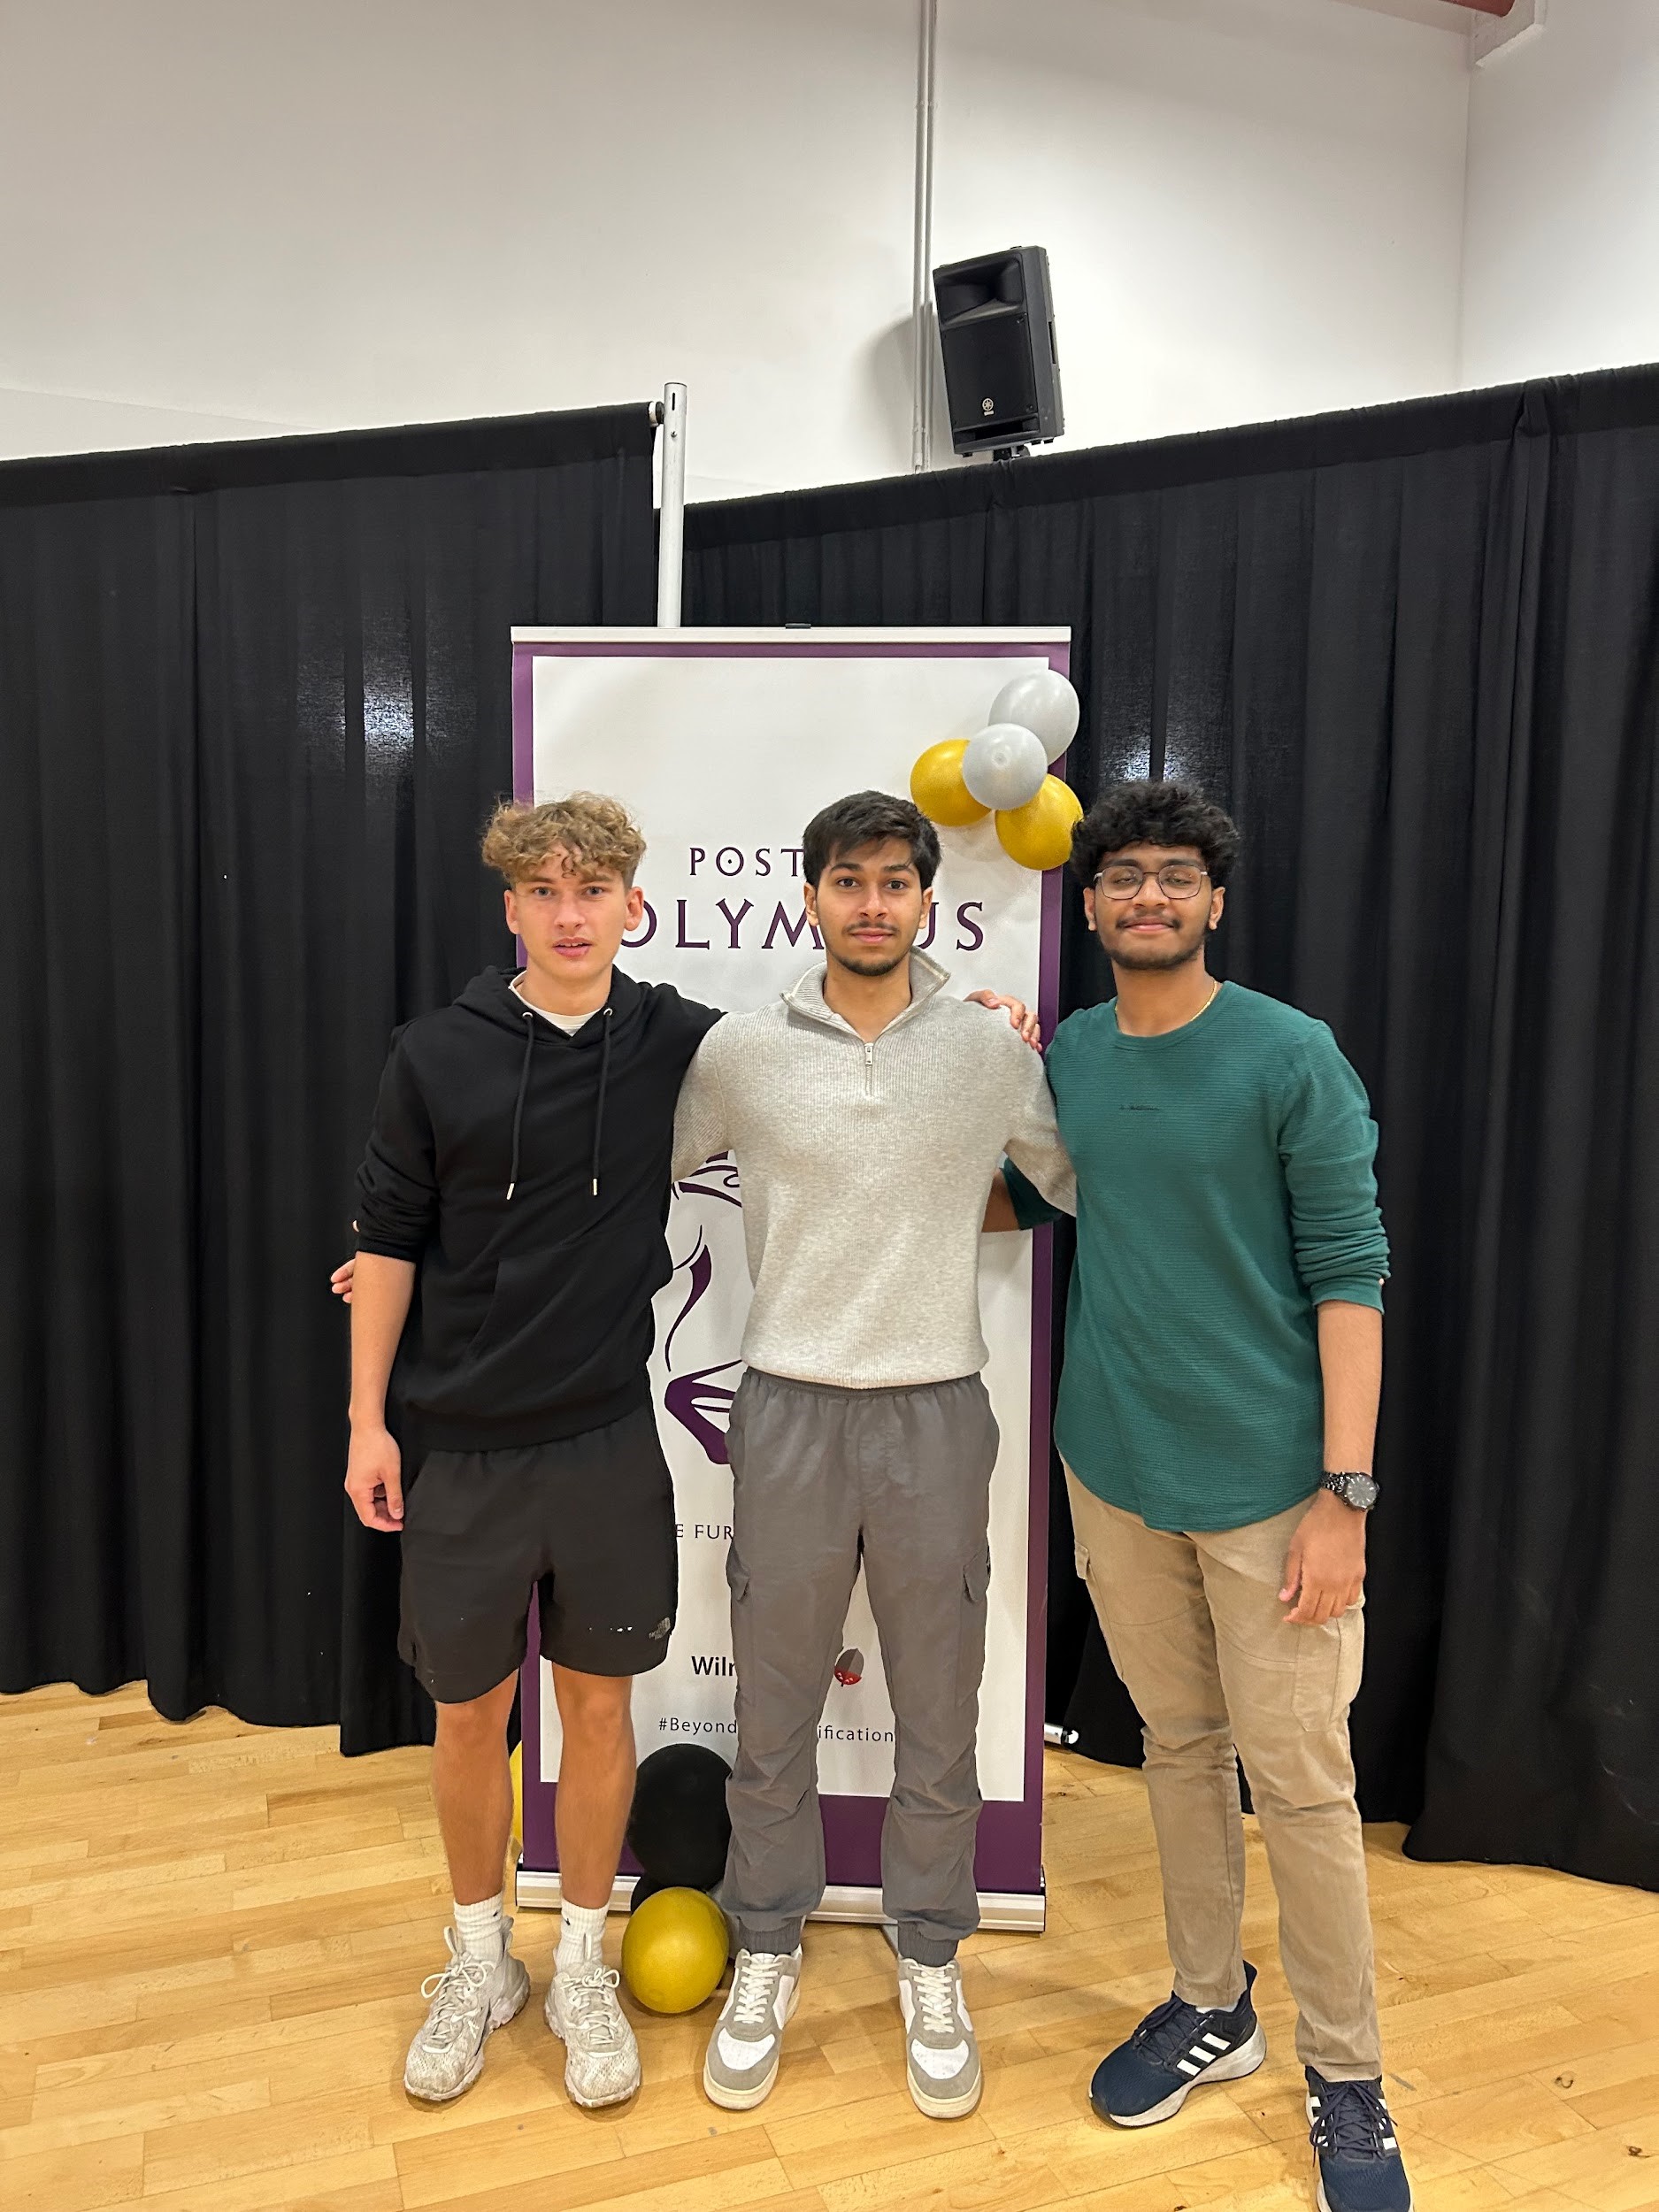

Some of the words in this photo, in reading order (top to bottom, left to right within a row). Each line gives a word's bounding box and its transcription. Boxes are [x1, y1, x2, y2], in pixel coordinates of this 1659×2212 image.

[689, 846, 804, 877] POST
[620, 897, 984, 951] OLYMS
[658, 1717, 737, 1736] #Beyond
